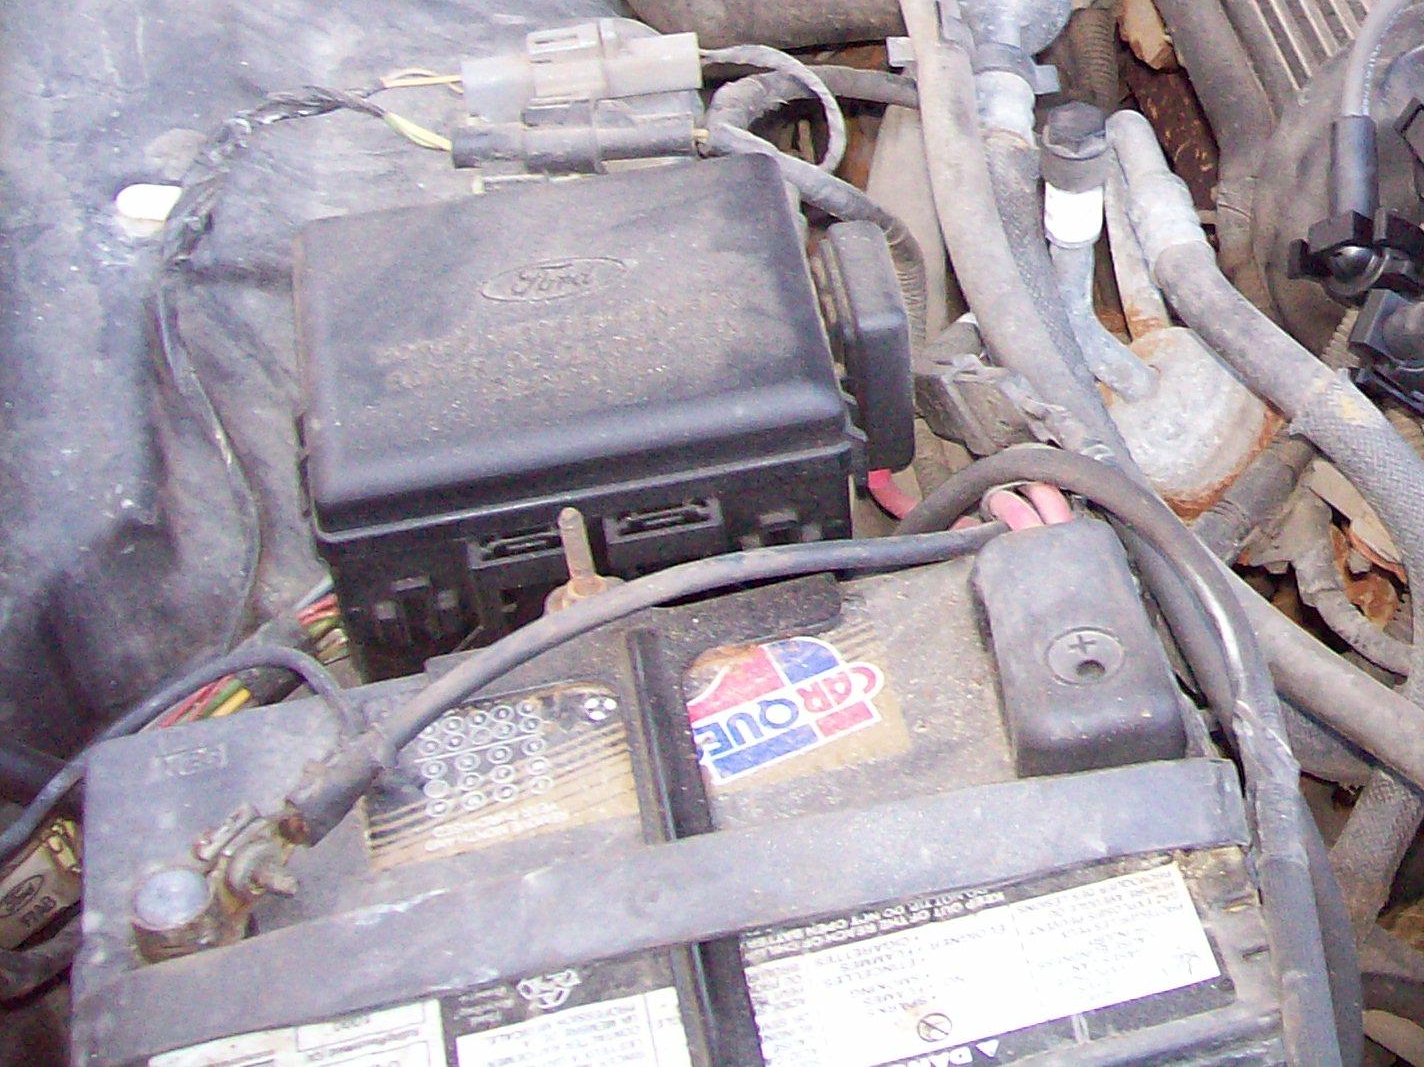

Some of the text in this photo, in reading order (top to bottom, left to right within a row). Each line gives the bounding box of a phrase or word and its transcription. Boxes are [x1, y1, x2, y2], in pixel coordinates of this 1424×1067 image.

[692, 664, 877, 761] CARQUE
[908, 909, 930, 923] OF
[933, 901, 963, 917] OUT
[879, 914, 908, 931] THE
[884, 1044, 974, 1067] DAN
